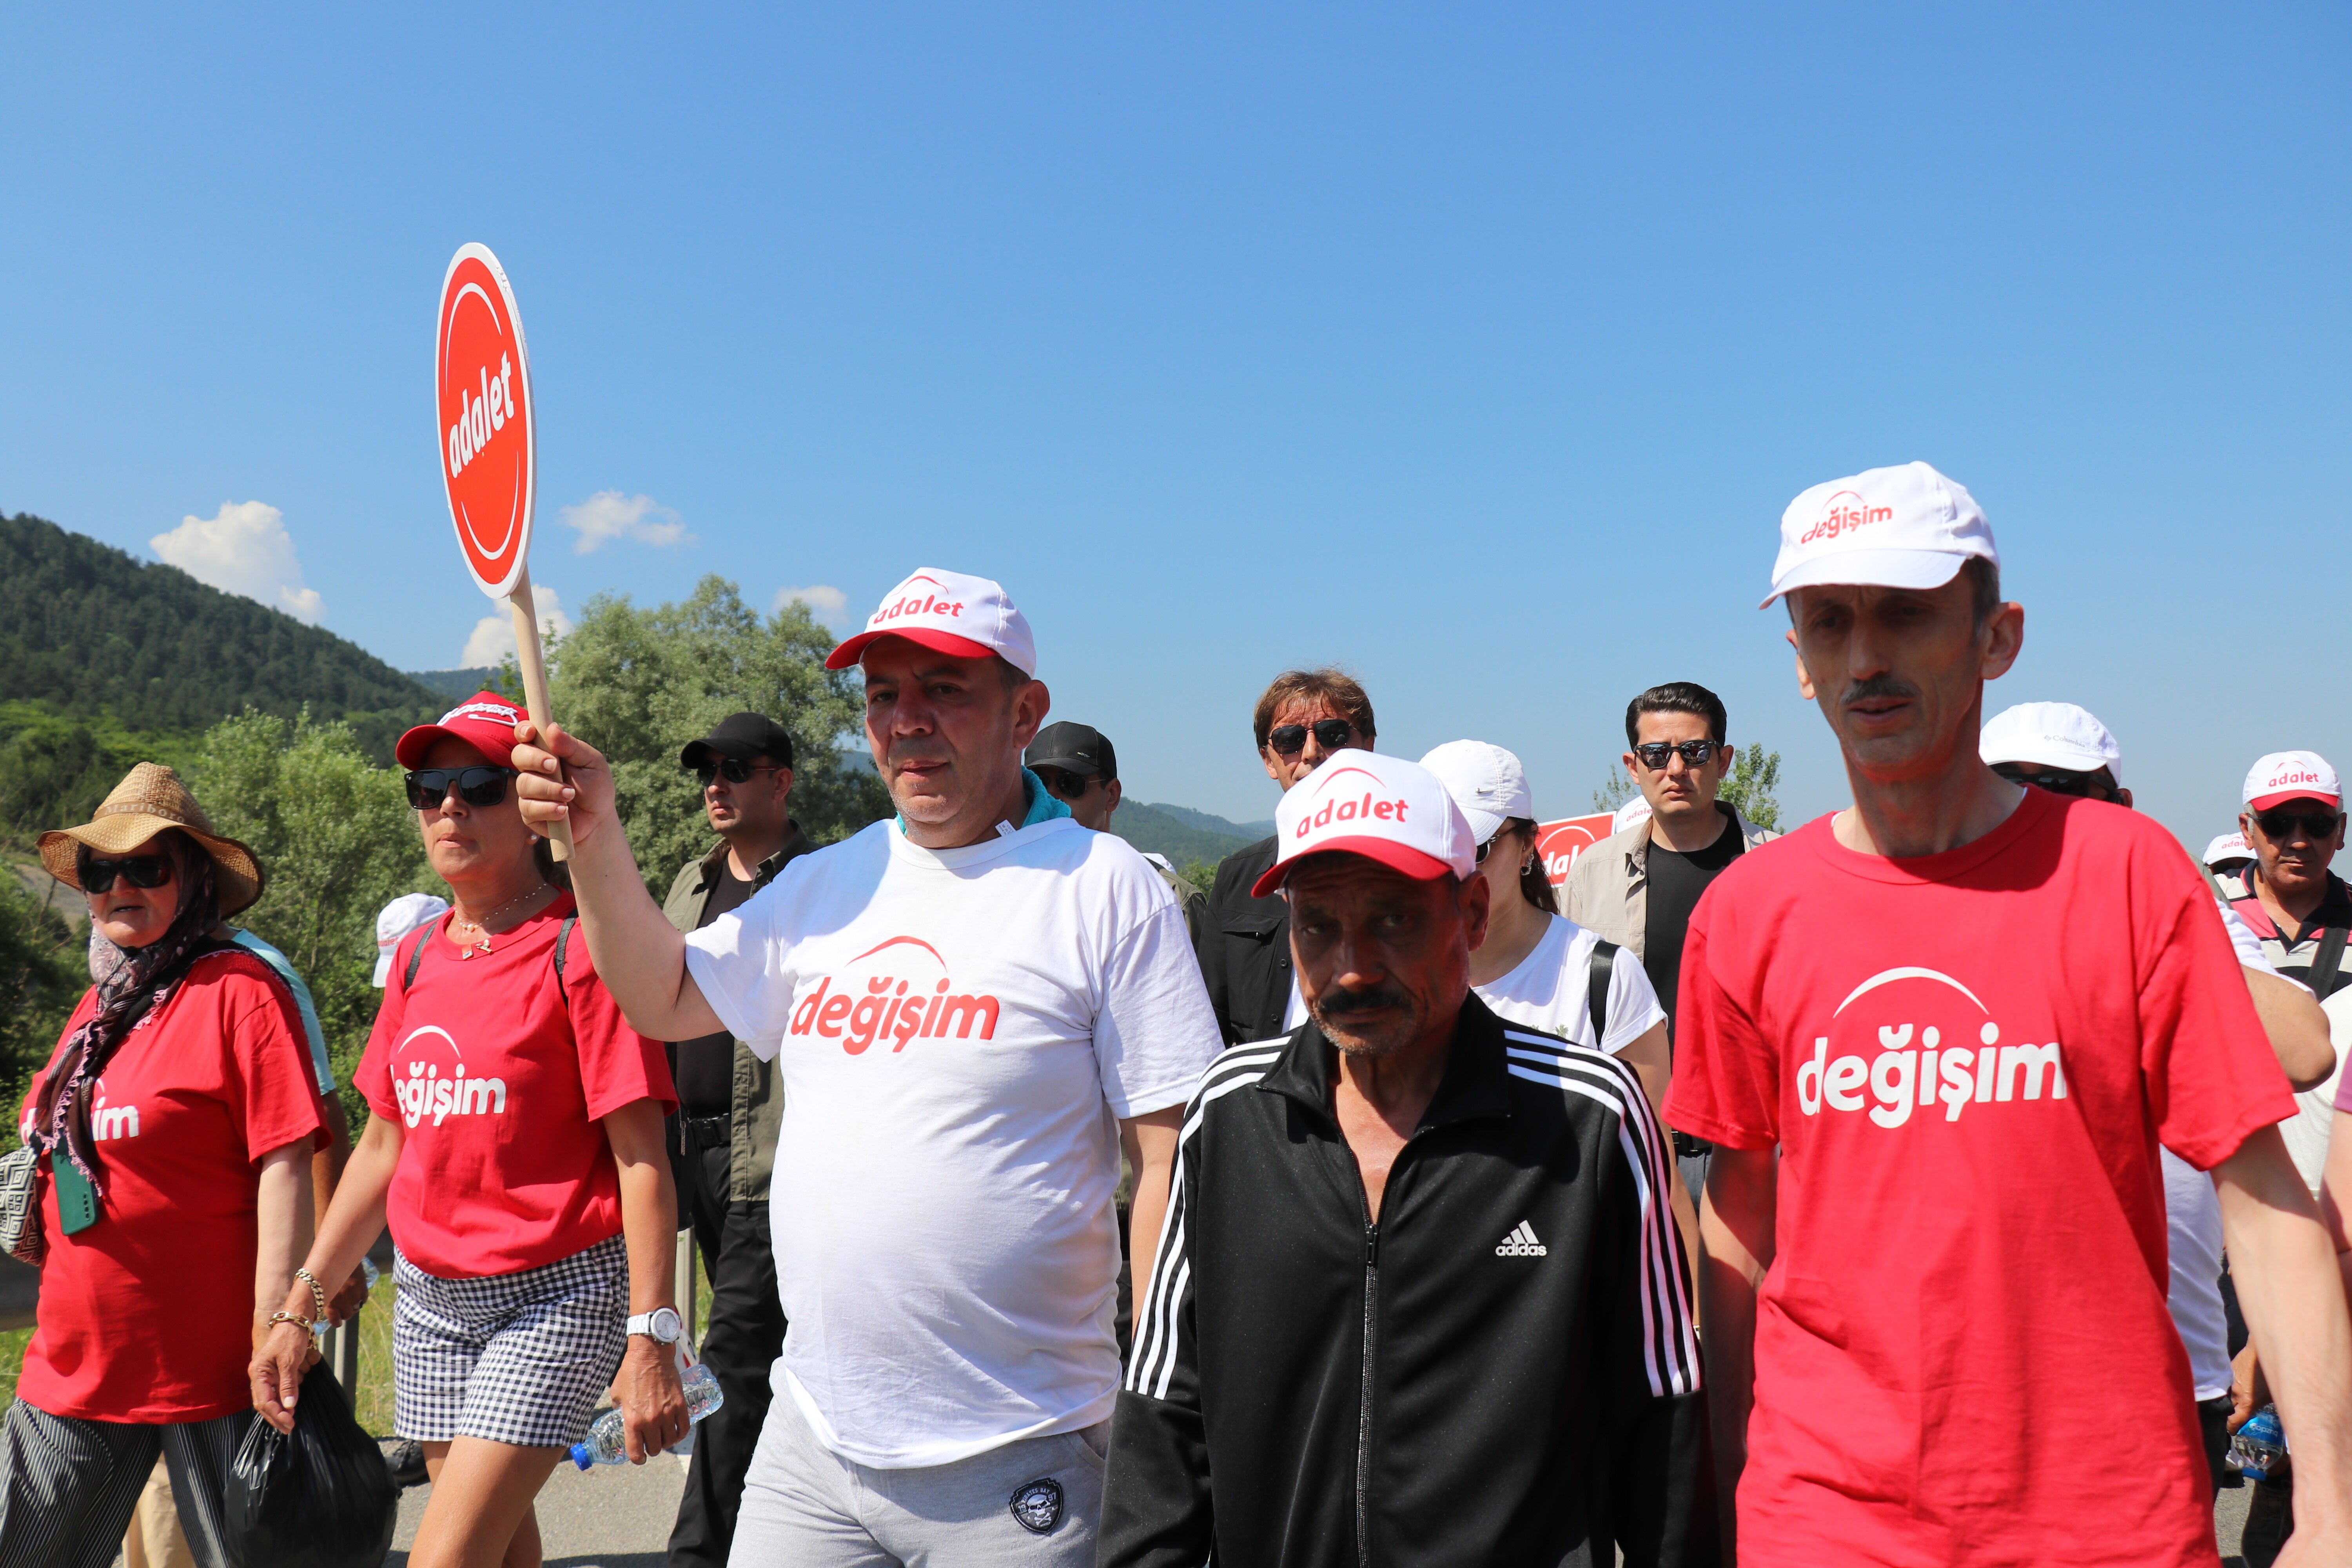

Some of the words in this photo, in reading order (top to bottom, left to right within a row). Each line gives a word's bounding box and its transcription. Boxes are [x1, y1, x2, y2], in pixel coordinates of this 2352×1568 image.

[449, 350, 515, 479] adalet
[1801, 505, 1893, 544] değişim
[873, 595, 964, 624] adalet
[2053, 735, 2085, 748] Columbia
[2268, 771, 2319, 787] adalet
[1296, 792, 1409, 839] adalet
[1626, 808, 1653, 822] adale
[2221, 840, 2245, 849] adal
[790, 976, 999, 1056] değişim
[1796, 1022, 2067, 1129] değişim
[390, 1061, 506, 1129] eğişim
[1495, 1243, 1547, 1256] adidas
[1021, 1488, 1038, 1503] PIRATES
[1048, 1492, 1056, 1502] 97
